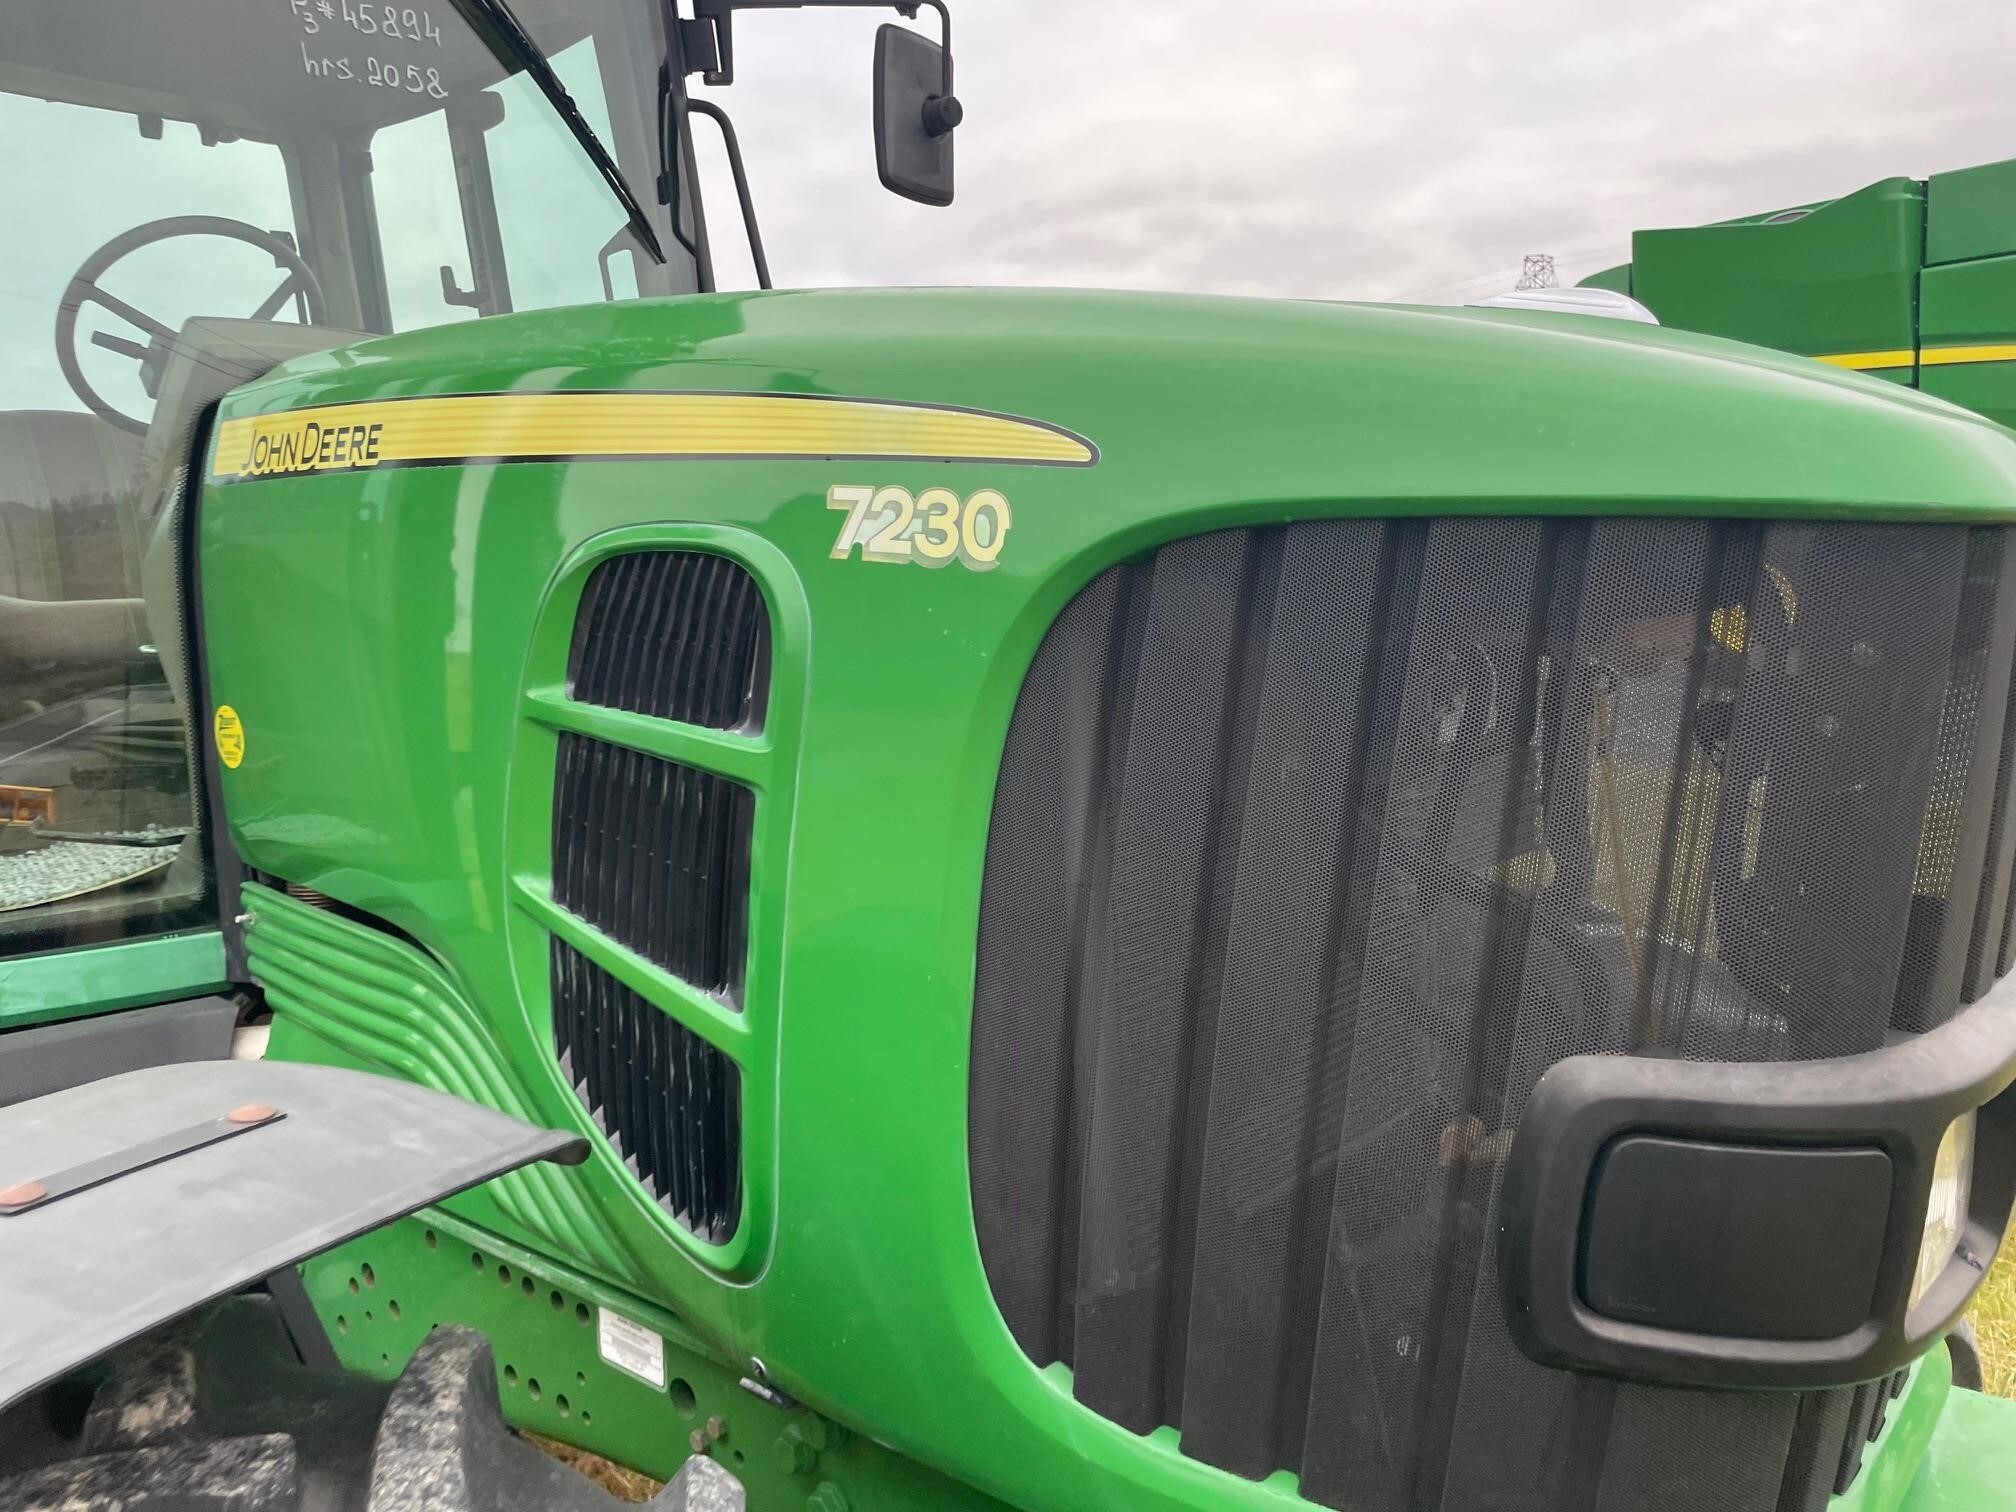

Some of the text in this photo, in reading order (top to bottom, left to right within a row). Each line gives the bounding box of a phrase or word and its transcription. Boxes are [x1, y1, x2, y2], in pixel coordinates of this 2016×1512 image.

[241, 422, 384, 470] JOHN DEERE
[827, 484, 1012, 572] 7230
